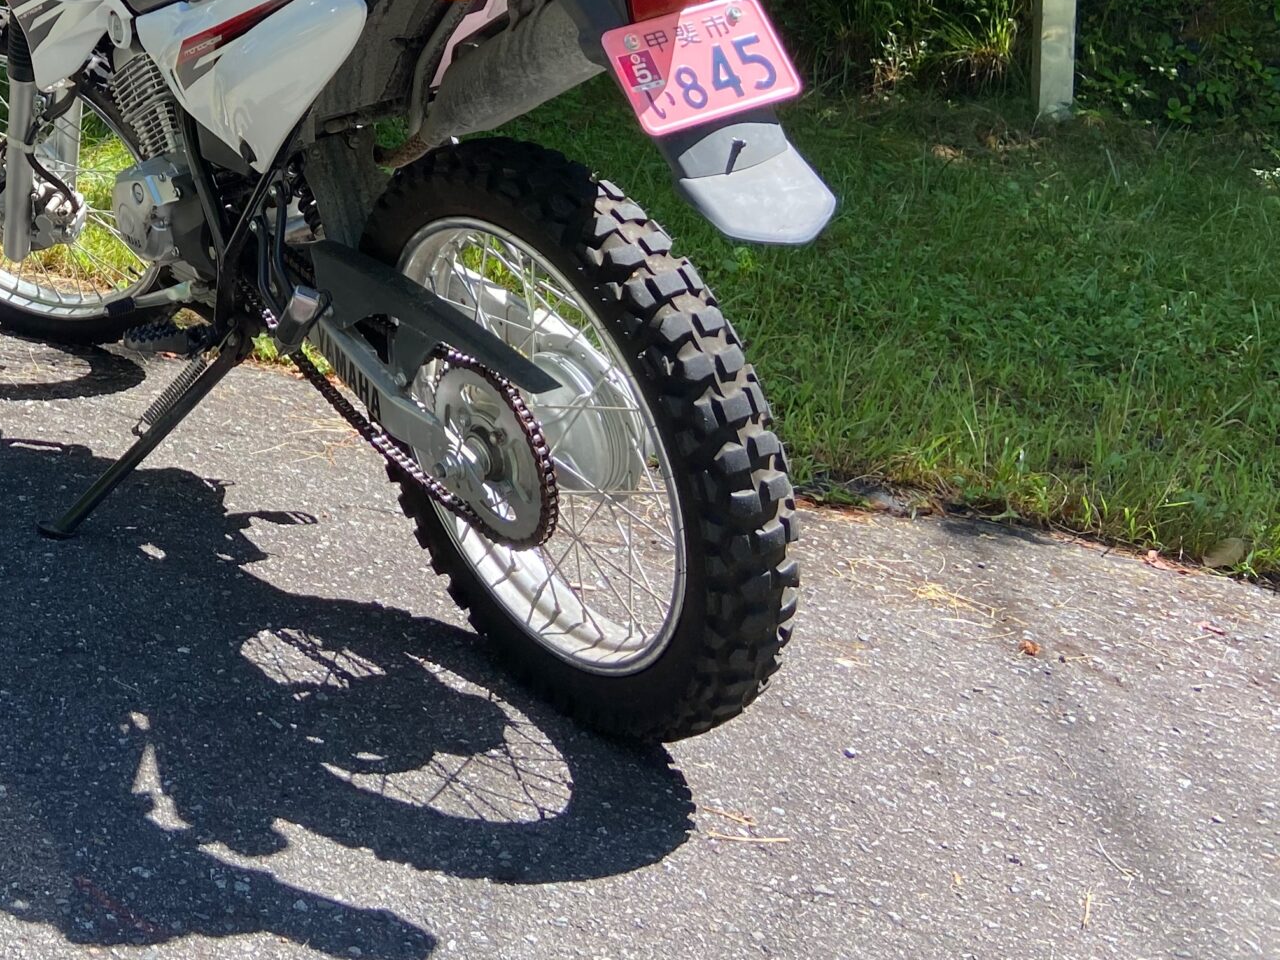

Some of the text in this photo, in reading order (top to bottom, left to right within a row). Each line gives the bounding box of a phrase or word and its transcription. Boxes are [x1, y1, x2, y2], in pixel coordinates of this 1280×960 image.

[643, 15, 730, 53] 甲斐市
[675, 34, 777, 110] 845
